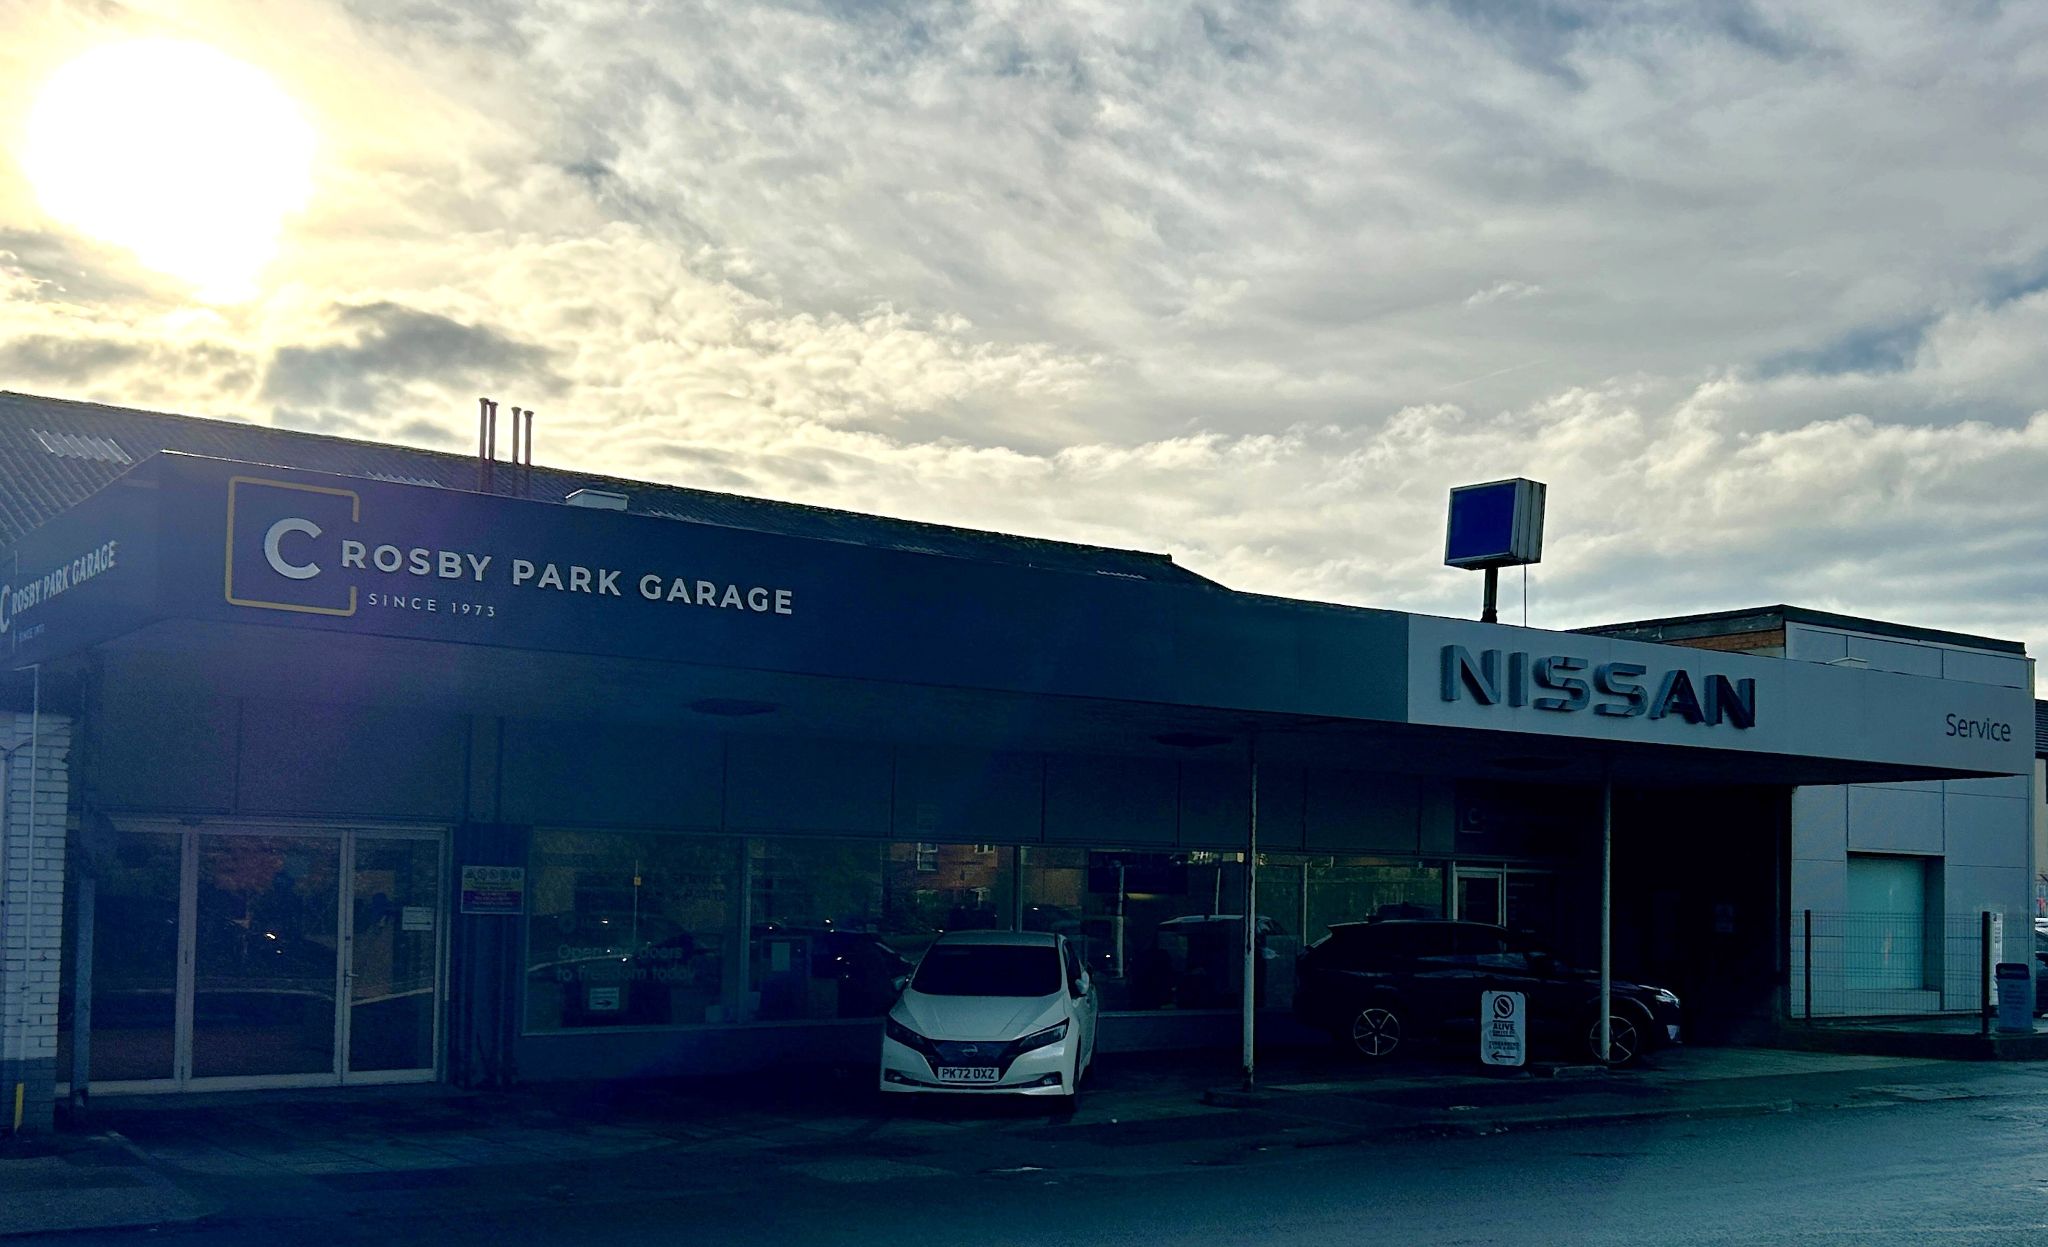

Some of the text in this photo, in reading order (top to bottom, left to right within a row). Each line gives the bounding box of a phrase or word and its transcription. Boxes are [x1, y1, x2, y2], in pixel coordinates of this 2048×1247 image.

[43, 564, 70, 601] PARK
[71, 540, 119, 586] GARAGE
[512, 559, 622, 597] PARK
[639, 574, 794, 616] GARAGE
[367, 592, 497, 618] SINCE 1973
[1440, 644, 1756, 730] NISSAN
[1946, 713, 2011, 742] Service
[942, 1068, 971, 1079] PK72
